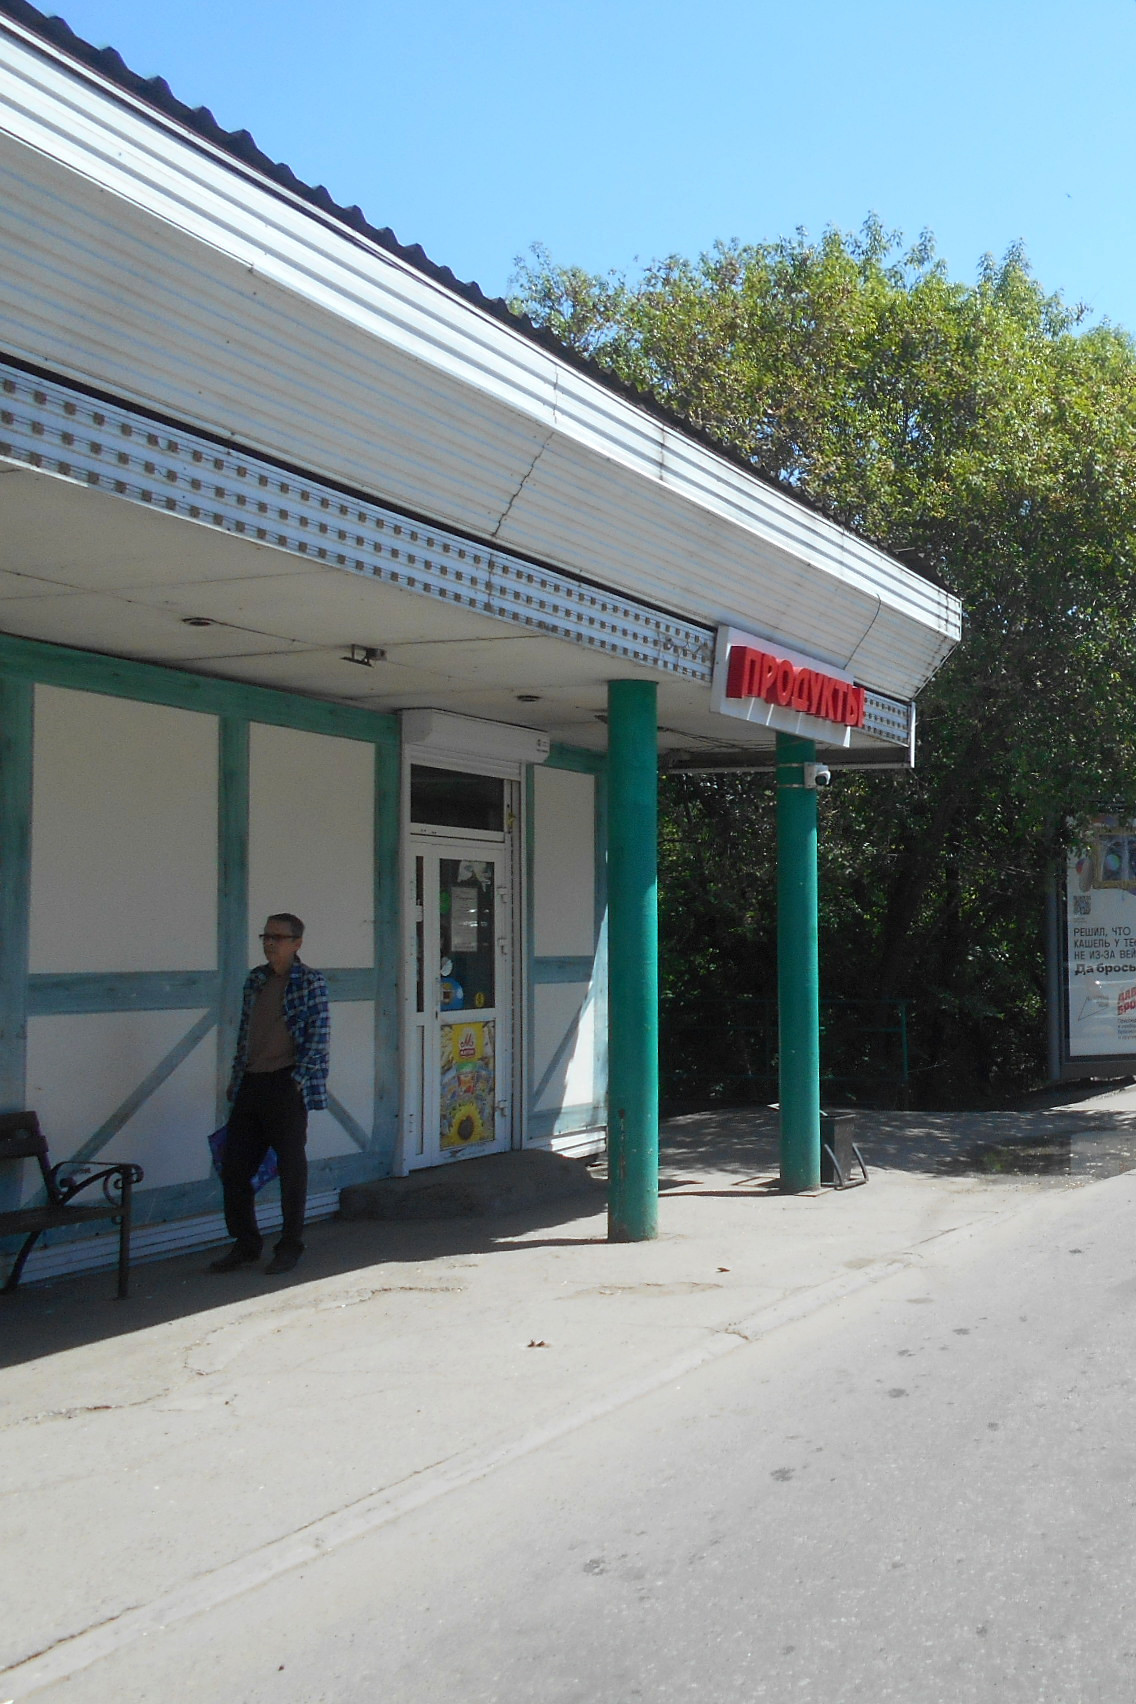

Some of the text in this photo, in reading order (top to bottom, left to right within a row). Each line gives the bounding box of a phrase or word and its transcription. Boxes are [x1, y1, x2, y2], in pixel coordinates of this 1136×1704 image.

[727, 645, 866, 728] ПРОДУКТЫ
[1073, 926, 1131, 937] РЕШИЛ, ЧТО
[1074, 938, 1110, 948] КАШЕЛЬ
[1114, 939, 1120, 948] У
[1074, 950, 1085, 960] НЕ
[1089, 950, 1115, 959] ИЗ-ЗА
[1075, 963, 1094, 975] Да
[1097, 963, 1136, 975] брось
